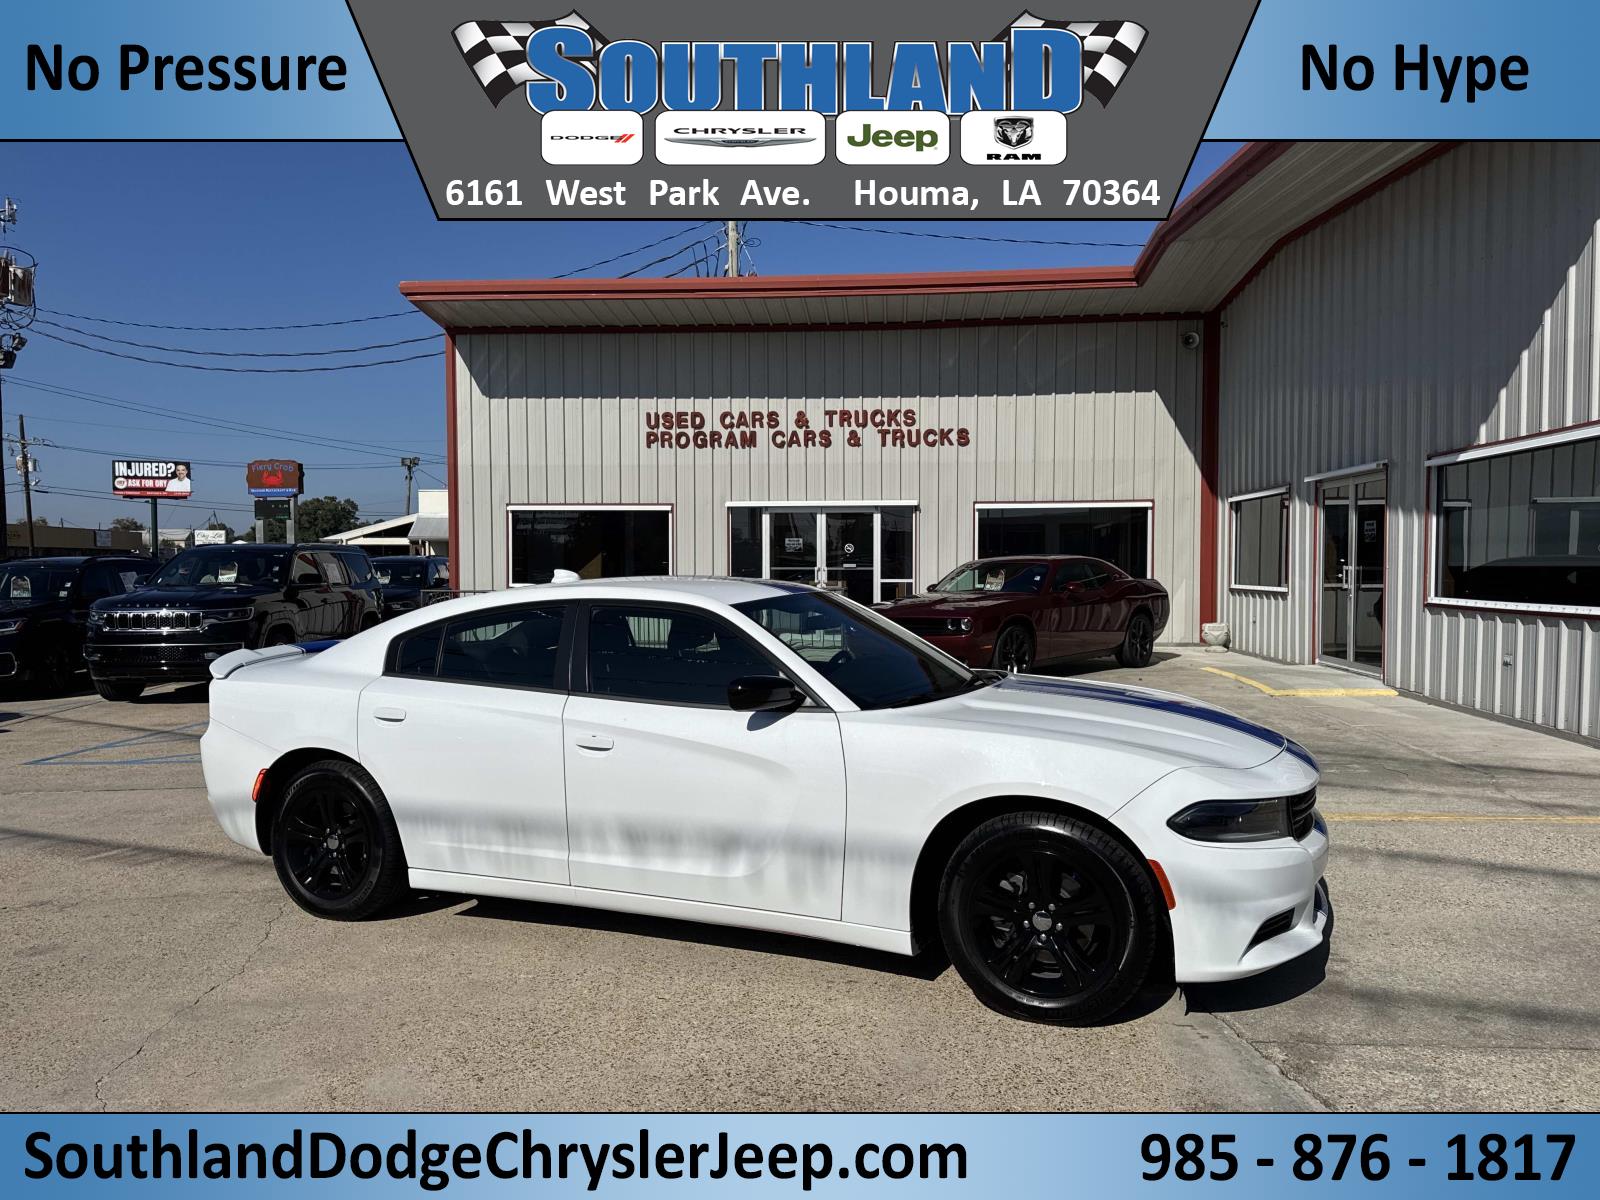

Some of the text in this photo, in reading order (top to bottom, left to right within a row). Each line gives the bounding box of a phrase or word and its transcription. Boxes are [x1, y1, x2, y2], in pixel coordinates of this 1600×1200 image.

[646, 409, 917, 430] USED CARS & TRUCKS
[646, 428, 971, 449] PROGRAM CARS & TRUCKS
[114, 461, 176, 477] INJURED?
[127, 479, 141, 488] ASK
[141, 479, 154, 488] FOR
